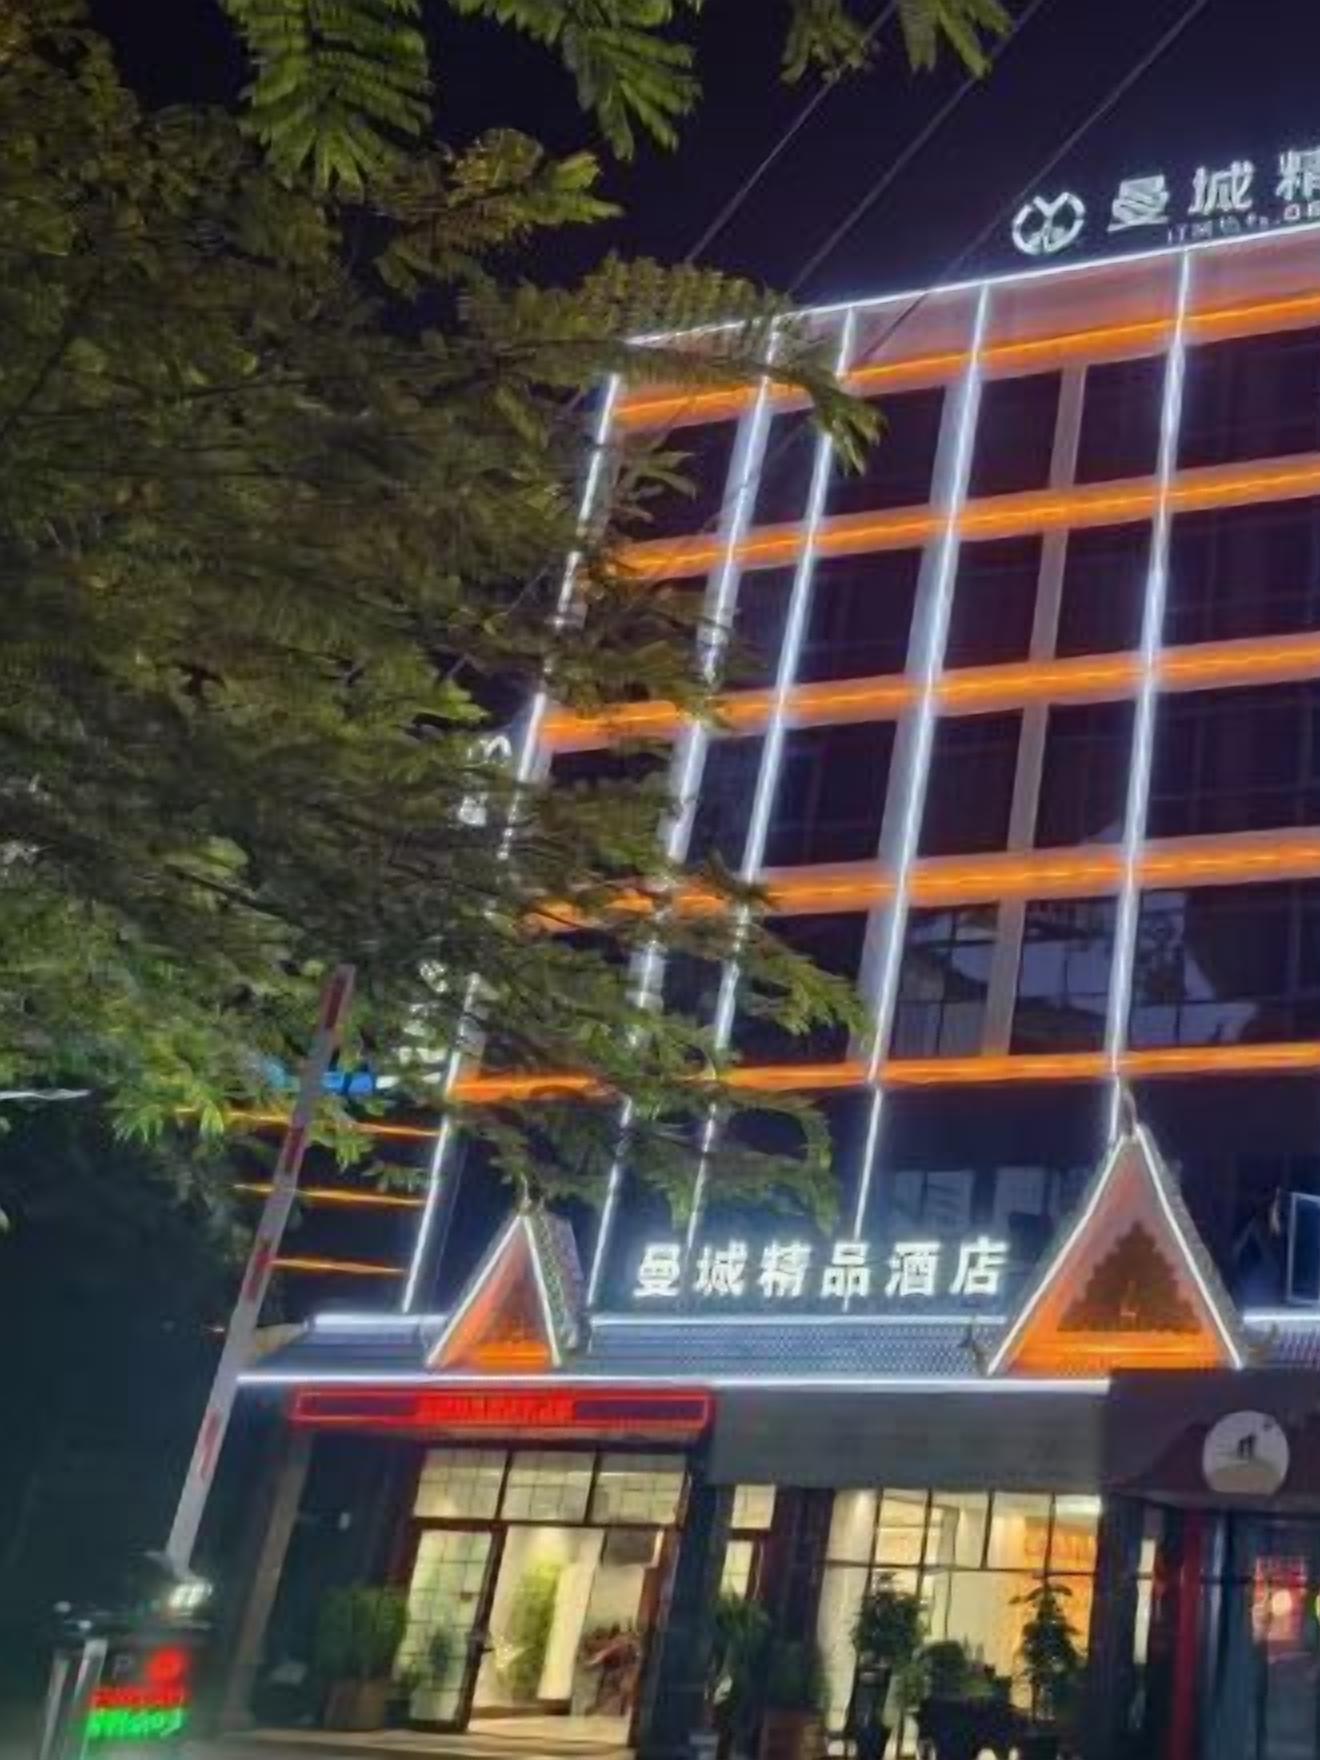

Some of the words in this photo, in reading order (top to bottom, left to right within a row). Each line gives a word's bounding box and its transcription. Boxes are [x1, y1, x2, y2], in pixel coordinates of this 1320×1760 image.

[632, 1235, 1010, 1297] 曼城精品酒店
